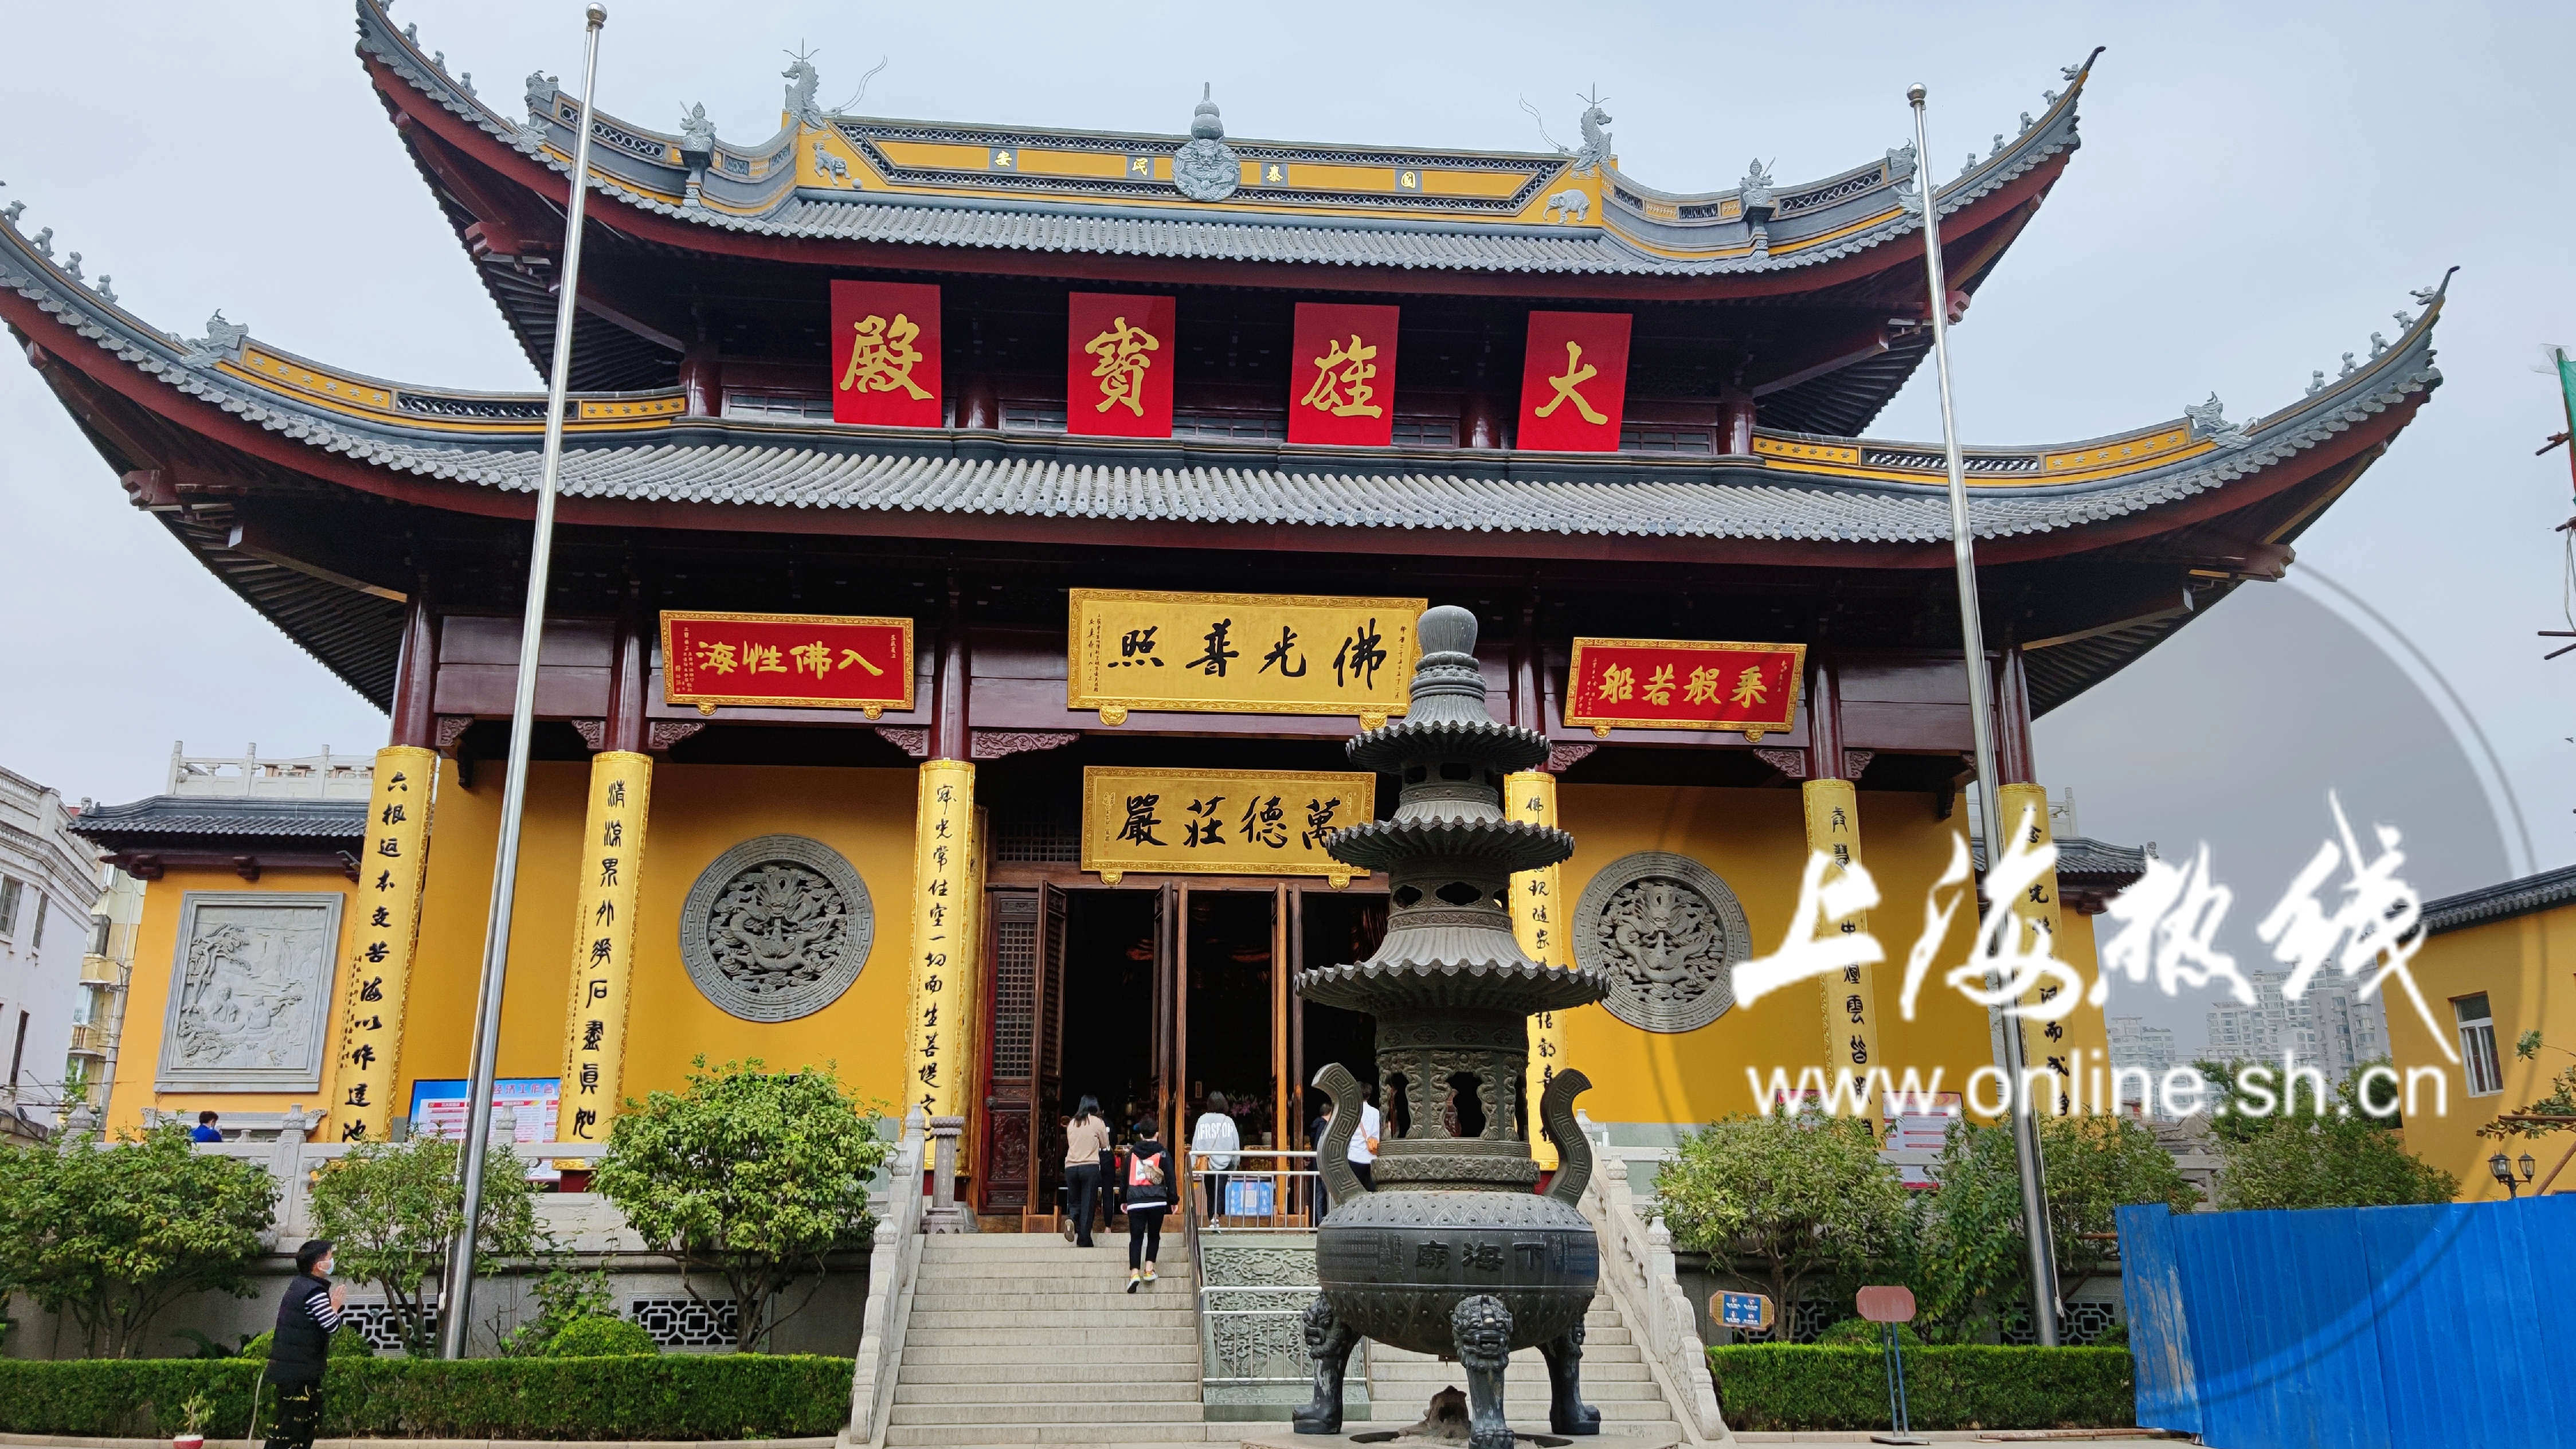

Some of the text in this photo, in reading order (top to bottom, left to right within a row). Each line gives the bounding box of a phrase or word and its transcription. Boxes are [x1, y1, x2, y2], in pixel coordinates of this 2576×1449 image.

[995, 150, 1012, 167] 安
[1132, 156, 1148, 176] 民
[1266, 164, 1283, 182] 泰
[840, 314, 934, 400] 殿
[1085, 316, 1159, 417] 寶
[1301, 334, 1383, 418] 雄
[1534, 340, 1608, 425] 大
